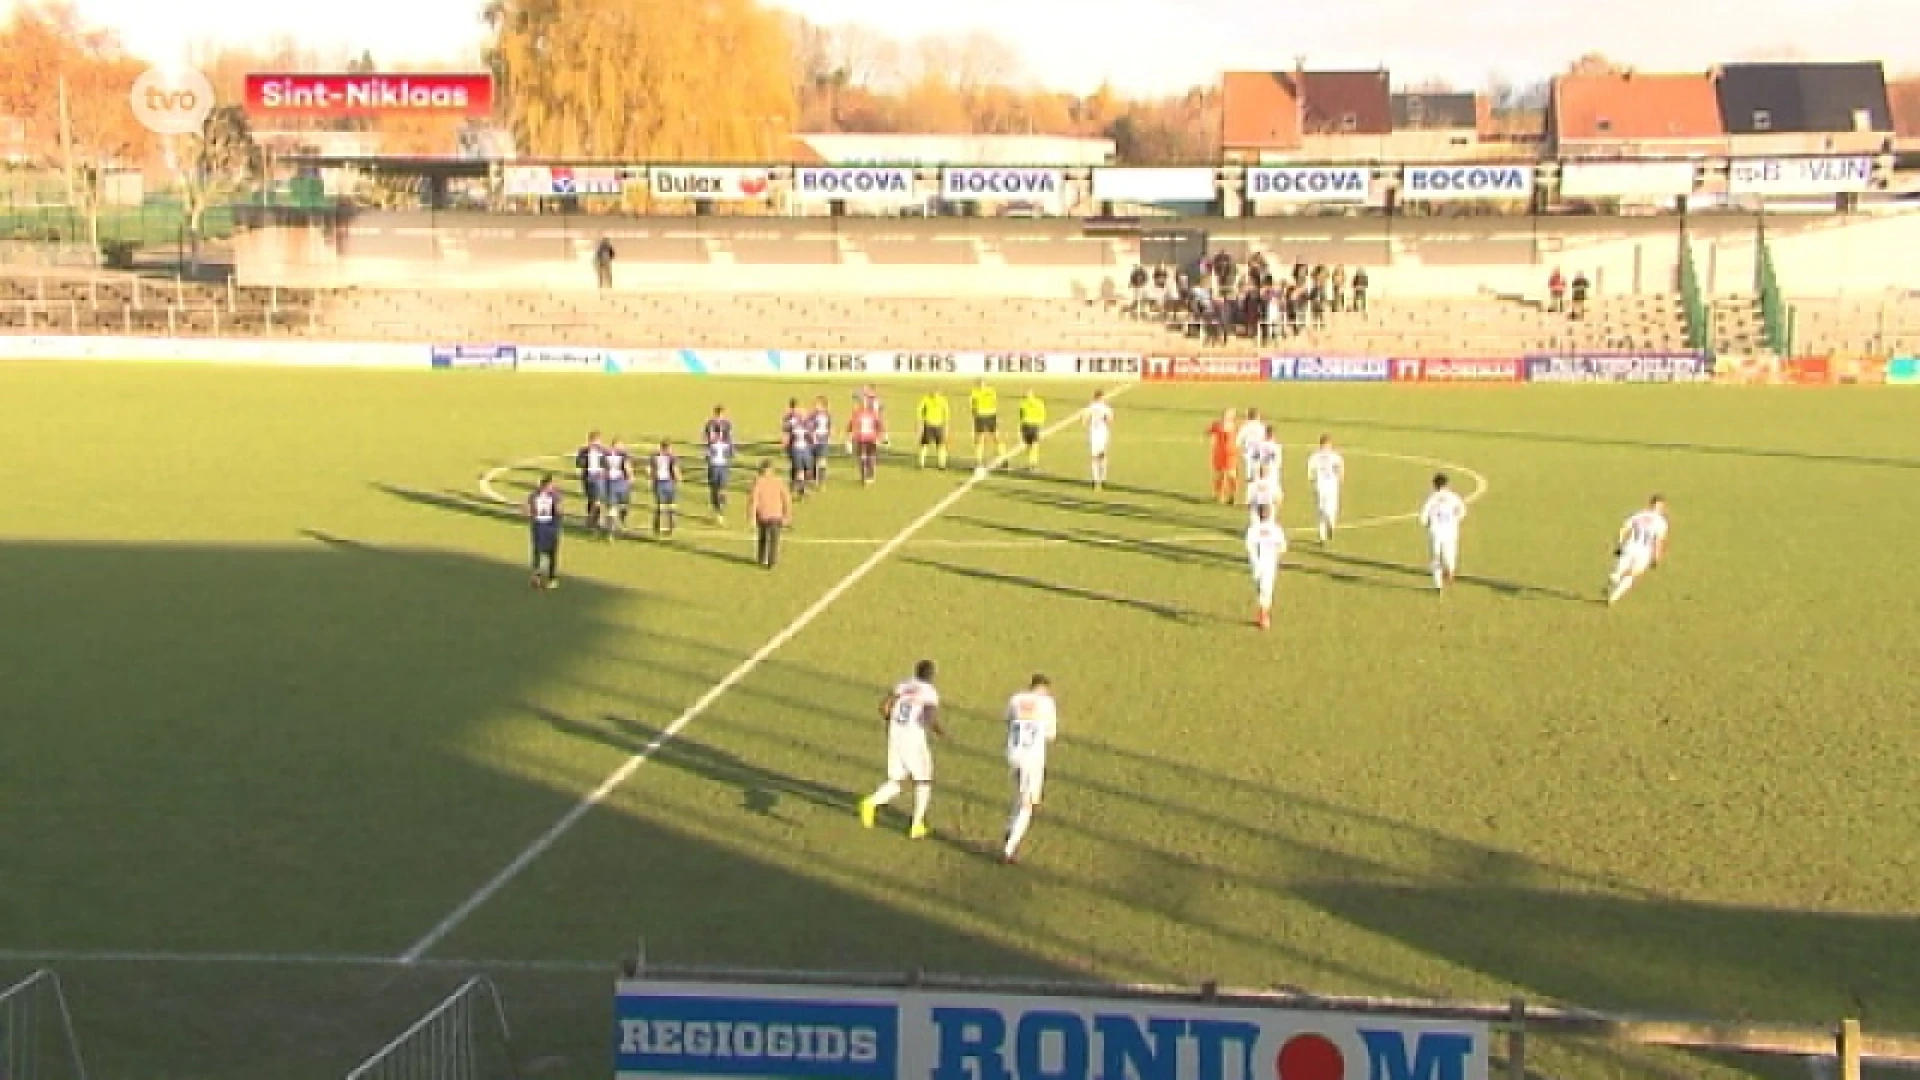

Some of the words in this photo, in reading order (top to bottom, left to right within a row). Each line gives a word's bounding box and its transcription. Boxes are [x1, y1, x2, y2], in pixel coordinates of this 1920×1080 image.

[802, 170, 908, 192] BOCOVA
[949, 170, 1055, 193] BOCOVA
[1253, 171, 1364, 193] BOCOVA
[1411, 168, 1524, 190] BOCOVA
[804, 353, 867, 372] FIERS
[893, 353, 957, 372] FIERS
[983, 354, 1046, 373] FIERS
[1074, 355, 1139, 373] FIERS
[618, 1018, 878, 1063] REGIOGIDS
